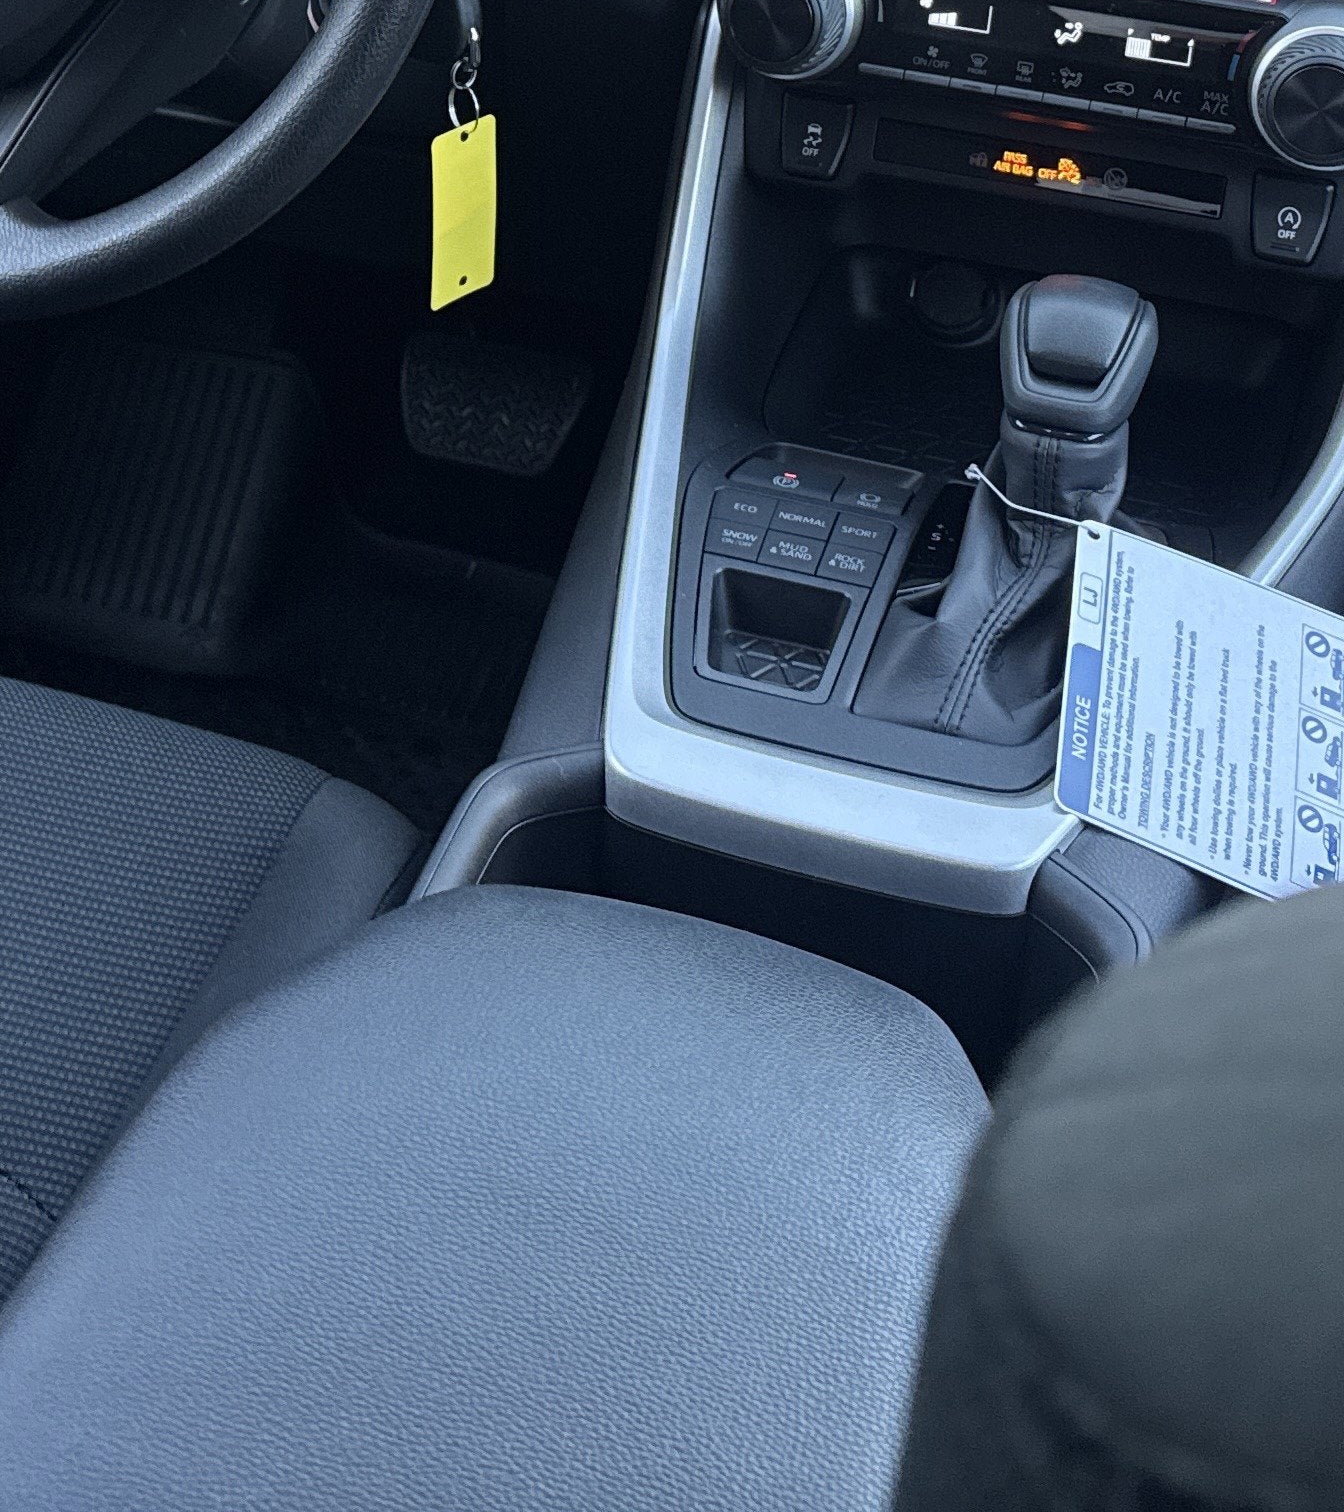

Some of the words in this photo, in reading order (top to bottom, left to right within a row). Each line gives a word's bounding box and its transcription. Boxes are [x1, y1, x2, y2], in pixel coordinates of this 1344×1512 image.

[912, 56, 951, 70] ON/OFF
[1153, 88, 1182, 104] A/C
[1203, 91, 1229, 104] MAX
[1200, 101, 1229, 116] A/C
[801, 146, 819, 157] OFF
[1003, 150, 1028, 165] PASS
[993, 160, 1011, 173] AIR
[1012, 163, 1034, 177] BAG
[1037, 167, 1058, 180] OFF
[1277, 228, 1296, 240] OFF
[733, 502, 758, 513] ECO
[778, 510, 827, 529] NORMAL
[722, 528, 758, 542] SNOW
[841, 524, 877, 539] SPORT
[769, 546, 777, 554] &
[778, 548, 813, 561] SAND
[778, 540, 809, 553] MUD
[828, 558, 836, 567] &
[838, 561, 867, 574] DIRT
[833, 552, 866, 565] ROCK
[1082, 586, 1098, 608] LJ
[1071, 694, 1092, 761] NOTICE
[1098, 711, 1110, 749] VEHICLE:
[1249, 733, 1259, 762] vehicle
[1264, 743, 1273, 767] cause
[1095, 750, 1107, 792] 4WD/AWD
[1109, 750, 1119, 786] methods
[1140, 731, 1155, 792] DESCRIPTION
[1106, 786, 1116, 816] proper
[1161, 769, 1173, 811] 4WD/AWD
[1190, 785, 1200, 814] wheels
[1117, 784, 1129, 820] Owner's
[1137, 791, 1151, 829] TOWING
[1261, 783, 1271, 822] operation
[1159, 812, 1170, 831] Your
[1188, 814, 1198, 833] four
[1209, 806, 1222, 836] towing
[1224, 807, 1236, 836] towing
[1247, 804, 1256, 827] your
[1273, 807, 1283, 838] system.
[1258, 822, 1269, 841] This
[1242, 843, 1252, 870] Never
[1258, 843, 1267, 877] ground.
[1269, 838, 1281, 881] 4WD/AWD
